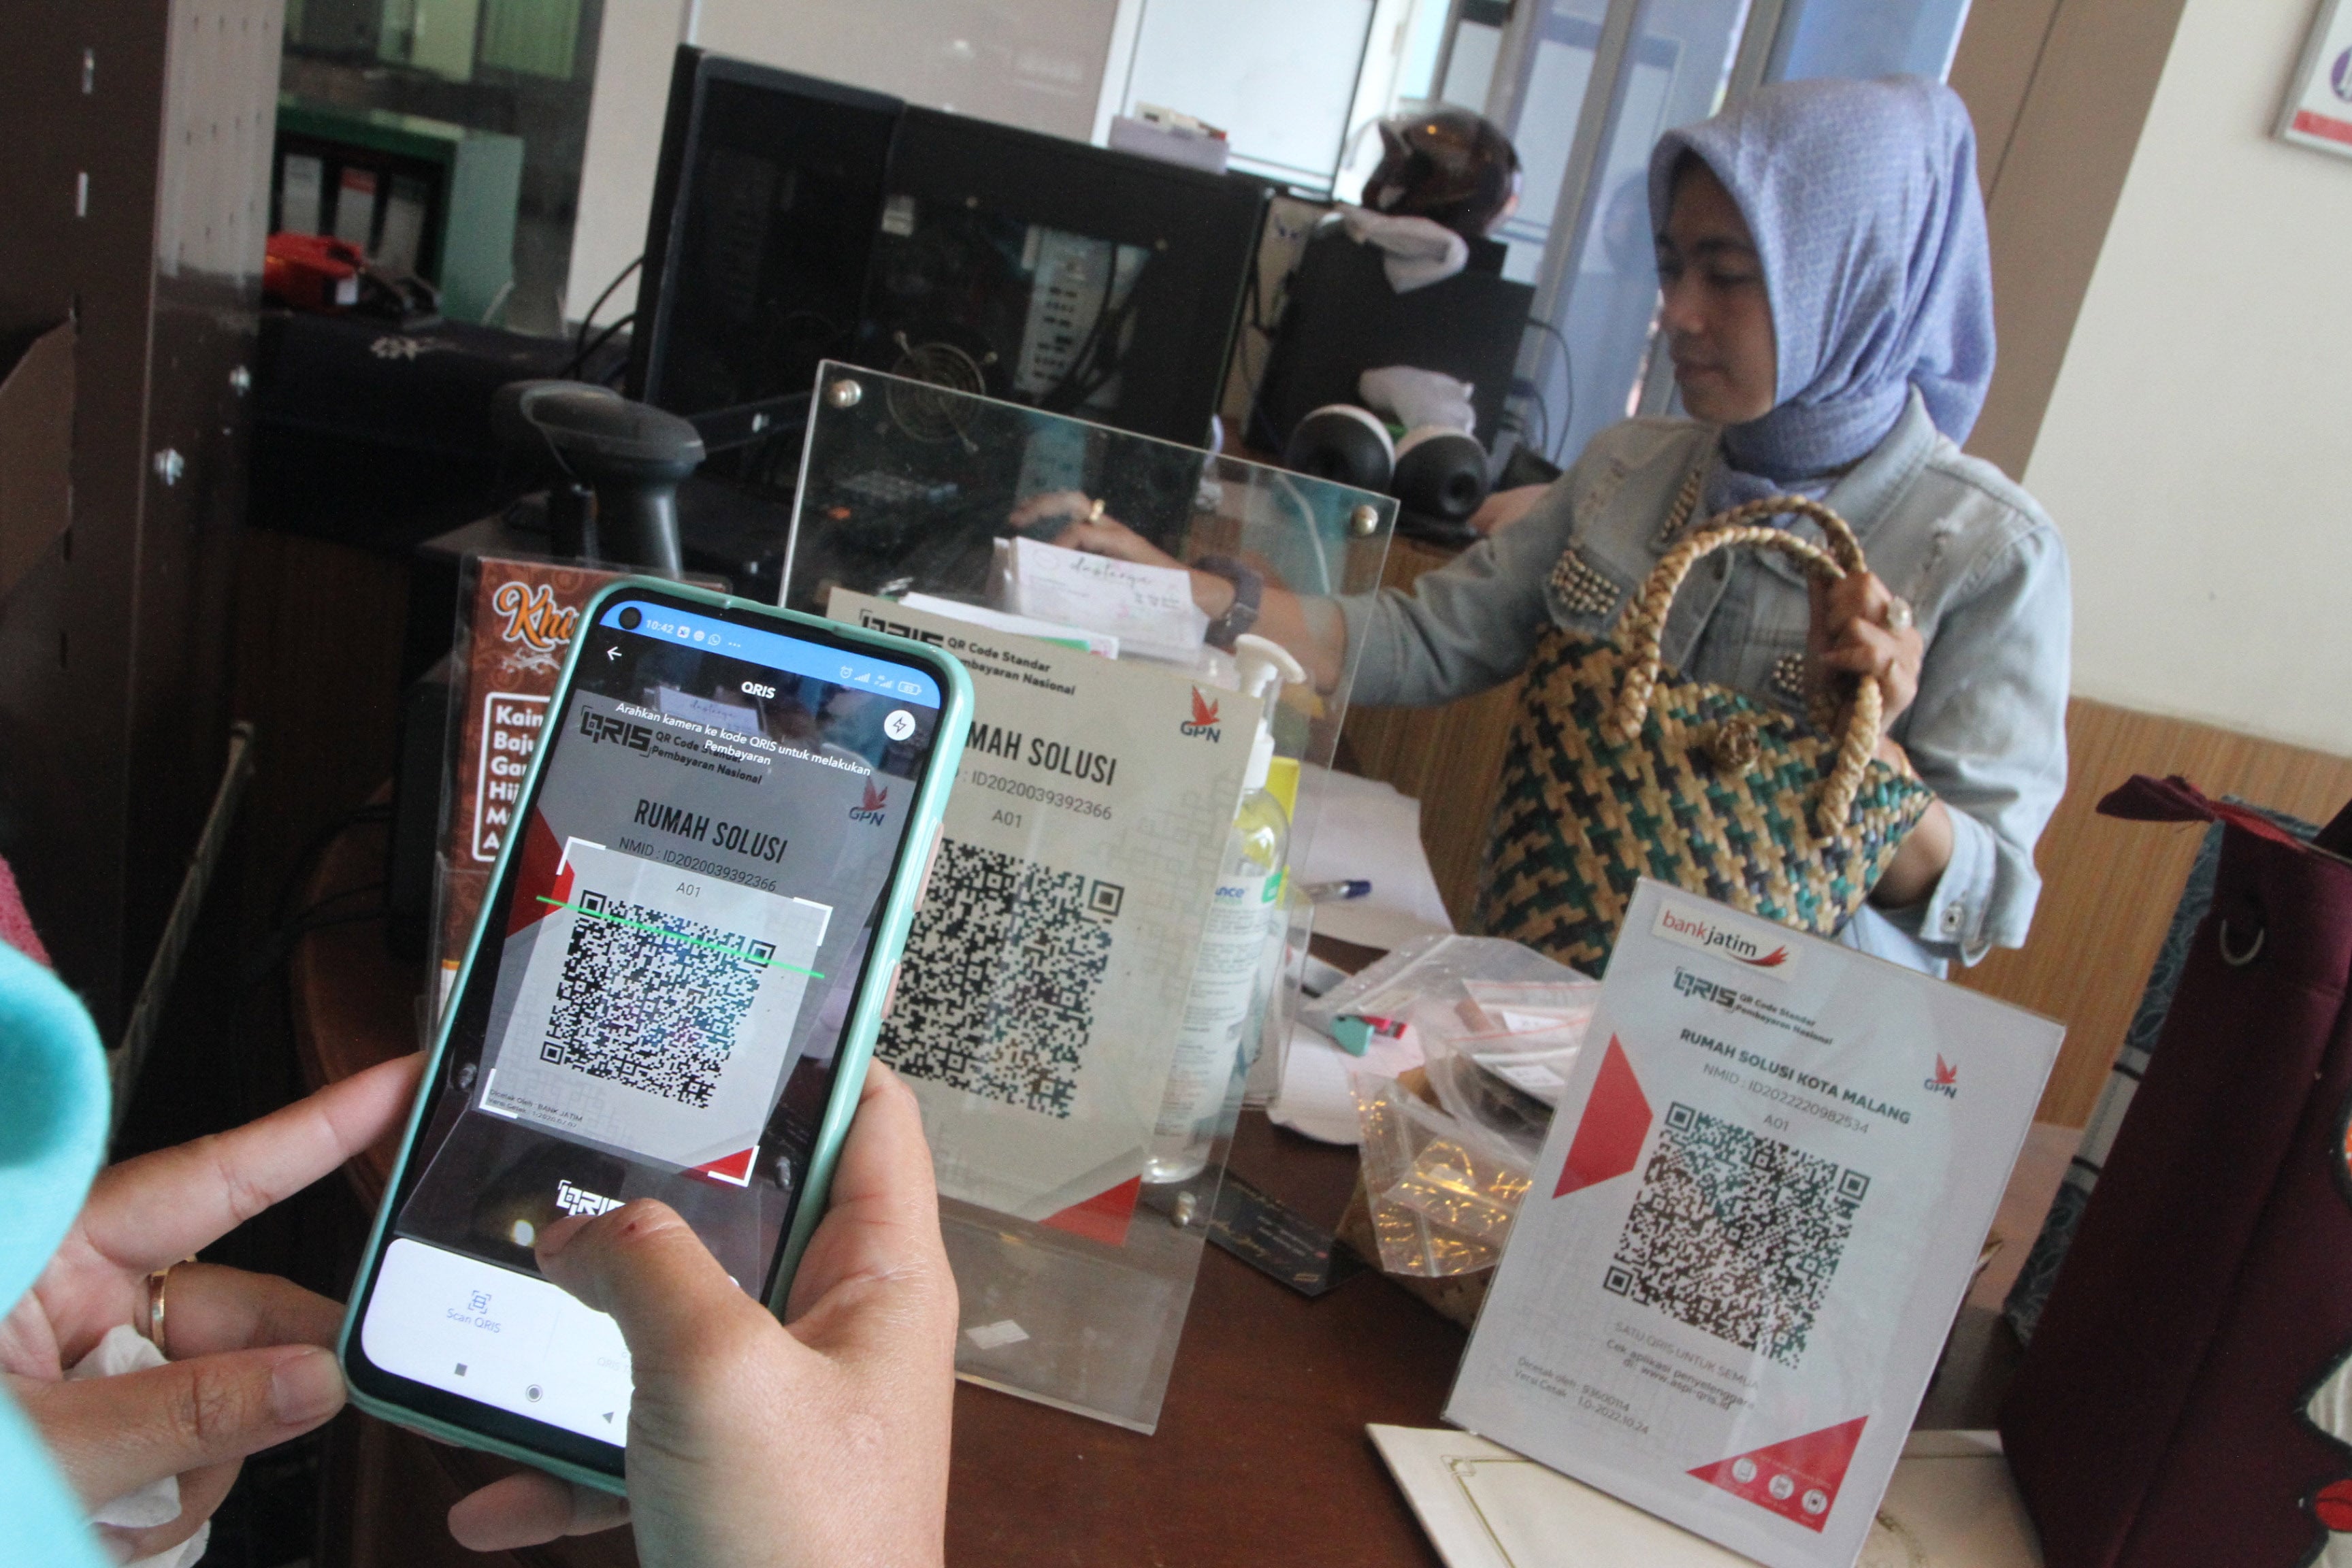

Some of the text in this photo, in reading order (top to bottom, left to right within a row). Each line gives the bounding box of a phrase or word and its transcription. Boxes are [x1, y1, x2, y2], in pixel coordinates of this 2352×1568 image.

[647, 620, 674, 634] 10:42
[947, 638, 1051, 672] QR Code Standar
[960, 658, 1076, 696] mbayaran Nasional
[741, 681, 776, 699] QRIS
[580, 709, 653, 754] QRIS
[615, 702, 871, 776] Arahkan kamera ke kode QRIS untuk melakukan
[655, 731, 671, 743] QR
[674, 736, 699, 751] Code
[1180, 721, 1221, 743] GPN
[651, 745, 762, 784] Pembayaran Nasional
[704, 740, 770, 765] Pembayaran
[966, 721, 1117, 787] MAH SOLUSI
[972, 770, 1112, 820] ID2020039392366
[849, 806, 885, 826] GPN
[992, 808, 1023, 828] A01
[634, 799, 788, 864] RUMAH SOLUSI
[619, 836, 654, 857] NMID
[663, 850, 777, 892] ID2020039392366
[676, 882, 702, 898] A01
[1662, 909, 1757, 957] bankjatim
[1673, 970, 1737, 1010] QRIS
[1740, 994, 1754, 1002] QR
[1754, 999, 1777, 1013] Code
[1680, 1028, 1912, 1125] RUMAH SOLUSI KOTA MALANG
[1703, 1063, 1740, 1085] NMID
[1923, 1078, 1958, 1100] GPN
[538, 1103, 559, 1115] BANK
[560, 1111, 583, 1122] JATIM
[1763, 1114, 1789, 1132] A01
[446, 1308, 501, 1334] Scan QRIS
[1676, 1348, 1716, 1372] UNTUK
